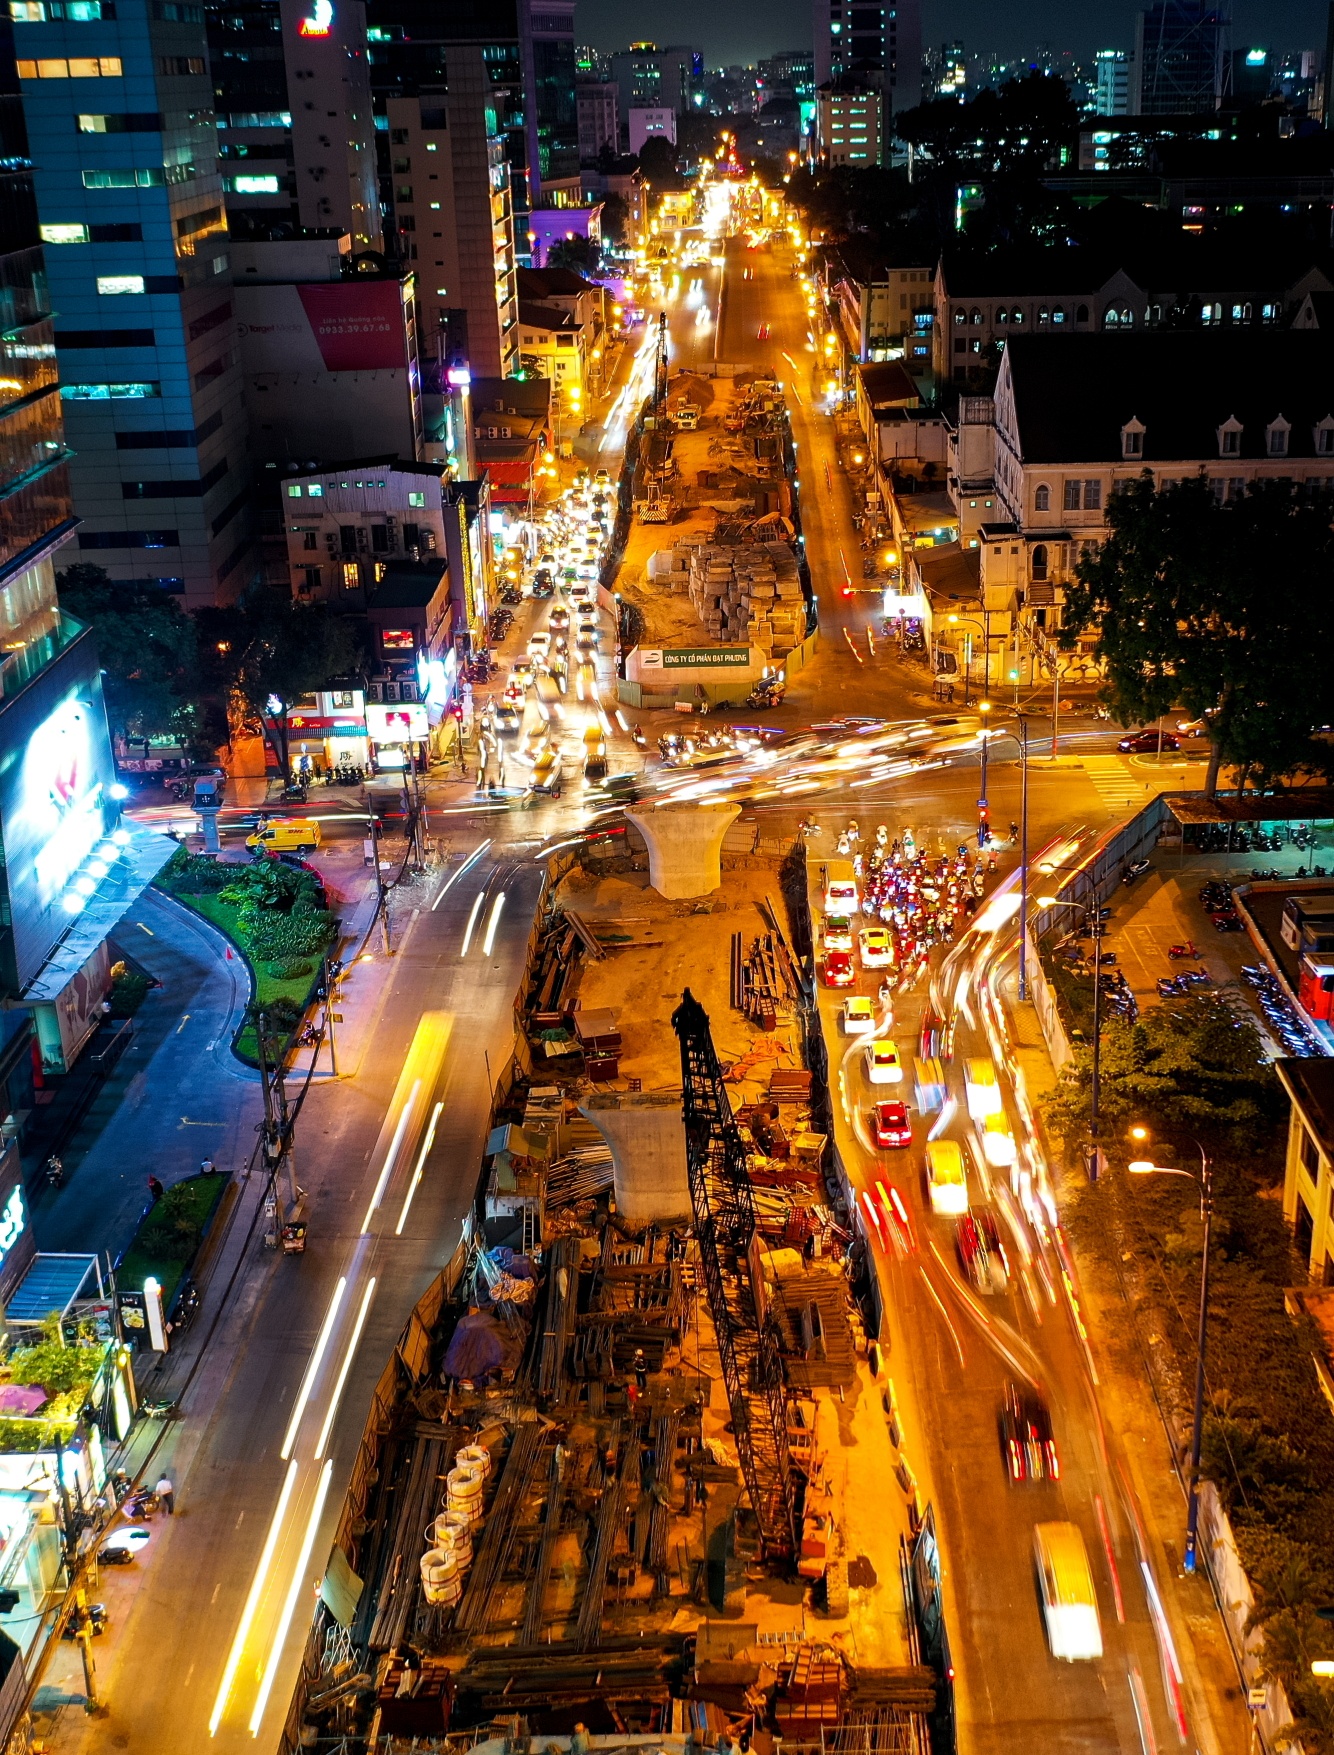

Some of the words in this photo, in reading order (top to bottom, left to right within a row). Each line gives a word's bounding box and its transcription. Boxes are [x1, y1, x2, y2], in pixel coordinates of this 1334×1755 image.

[249, 324, 274, 333] Target
[320, 324, 390, 334] 0933.39.67.68
[665, 654, 679, 662] CÔNG
